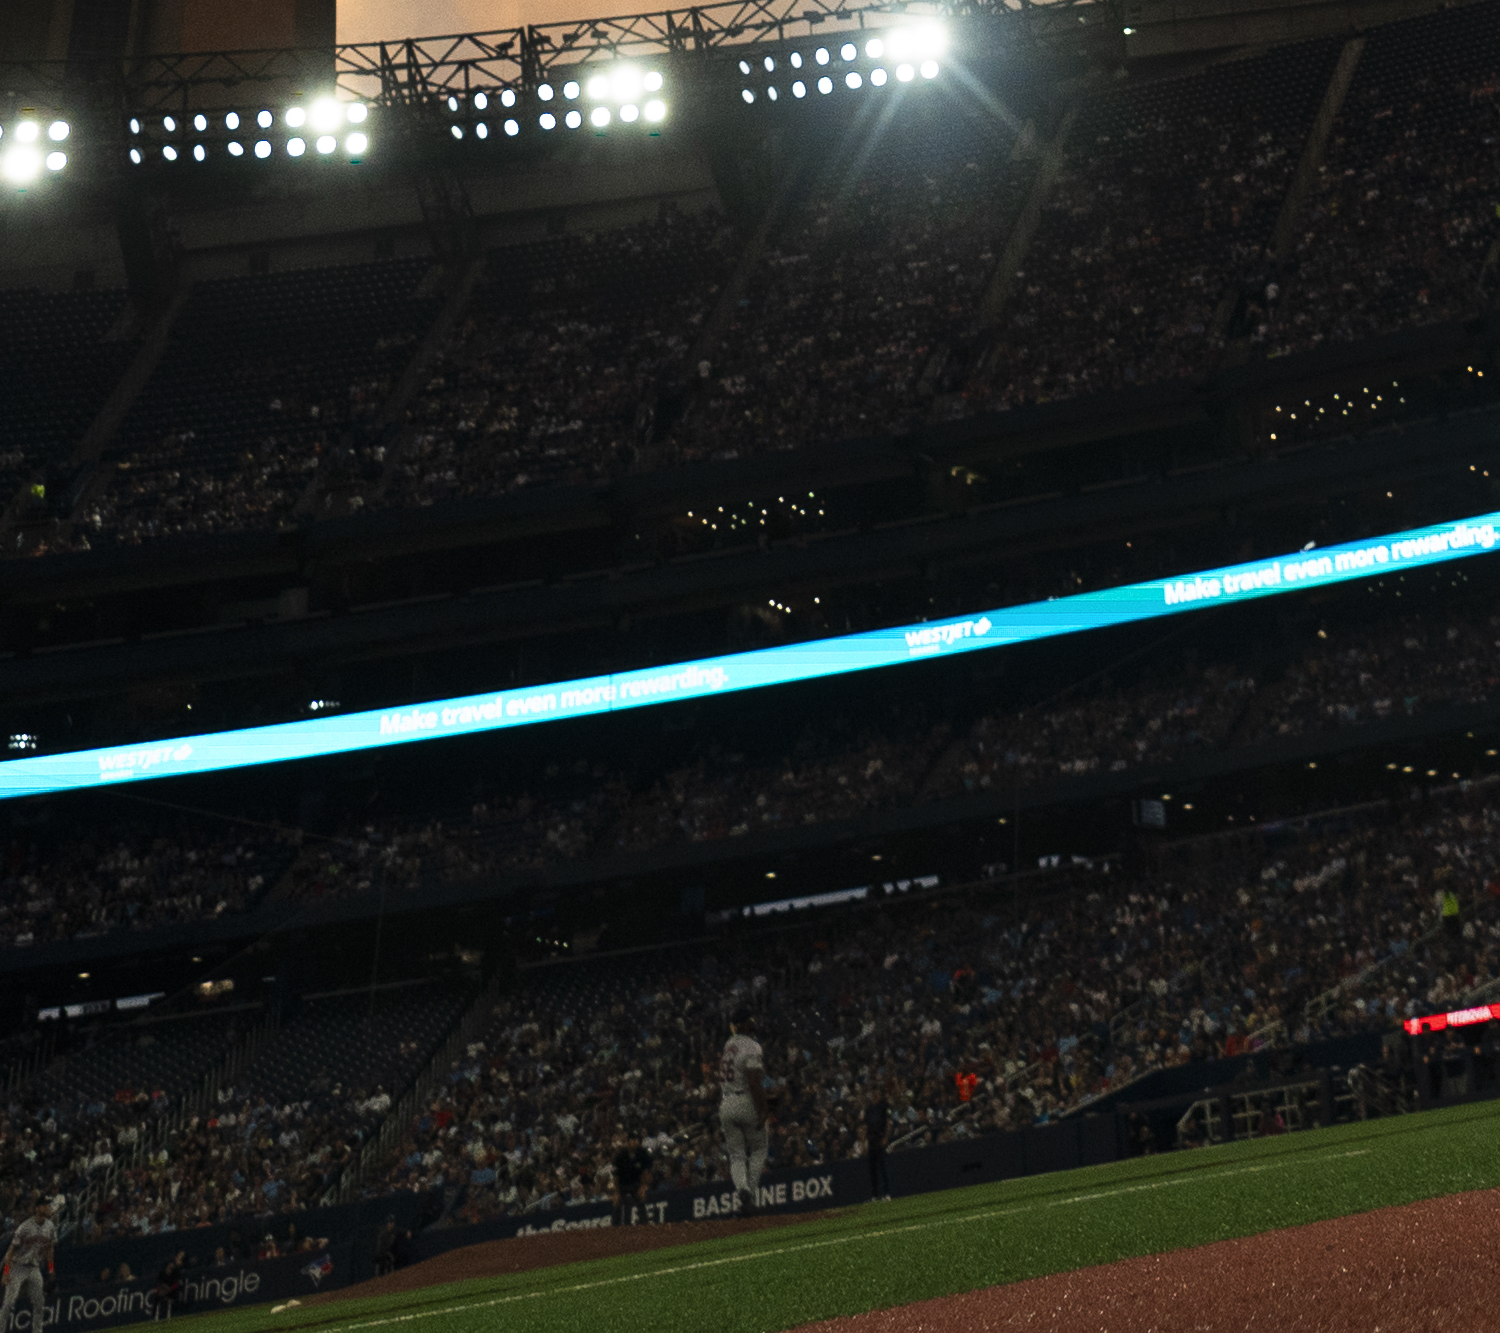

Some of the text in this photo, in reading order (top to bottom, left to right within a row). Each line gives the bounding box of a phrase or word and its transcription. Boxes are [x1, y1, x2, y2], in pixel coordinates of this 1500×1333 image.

[1164, 576, 1221, 605] Make
[1223, 562, 1281, 594] travel
[1283, 554, 1332, 582] even
[1335, 544, 1389, 571] more
[379, 710, 438, 736] Make
[441, 697, 503, 727] travel
[506, 691, 557, 716] even
[560, 683, 616, 708] more
[792, 1175, 834, 1202] BOX
[67, 1284, 158, 1322] Roofing
